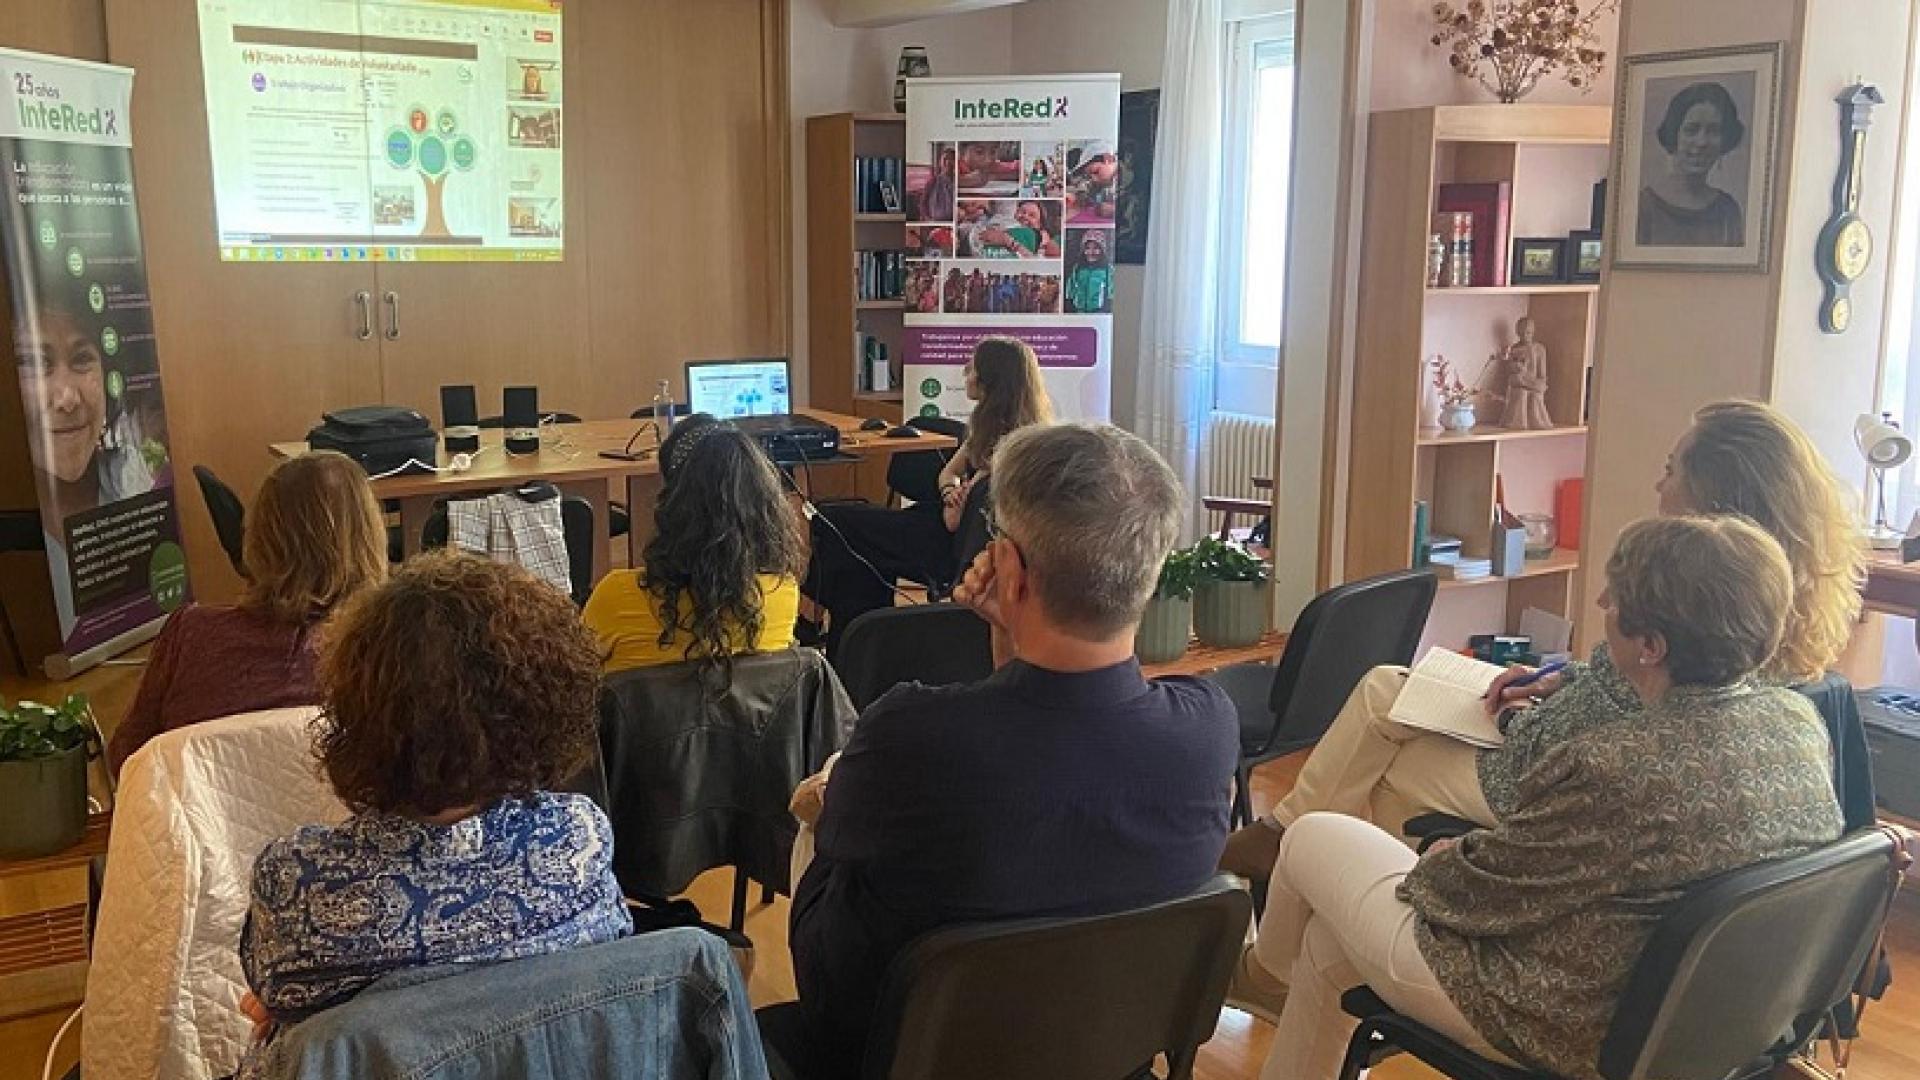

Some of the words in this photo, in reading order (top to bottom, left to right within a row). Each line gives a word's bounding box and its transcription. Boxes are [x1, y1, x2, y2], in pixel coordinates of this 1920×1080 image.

[14, 72, 34, 95] 25
[18, 97, 102, 135] InteRed
[954, 96, 1052, 119] InteRed
